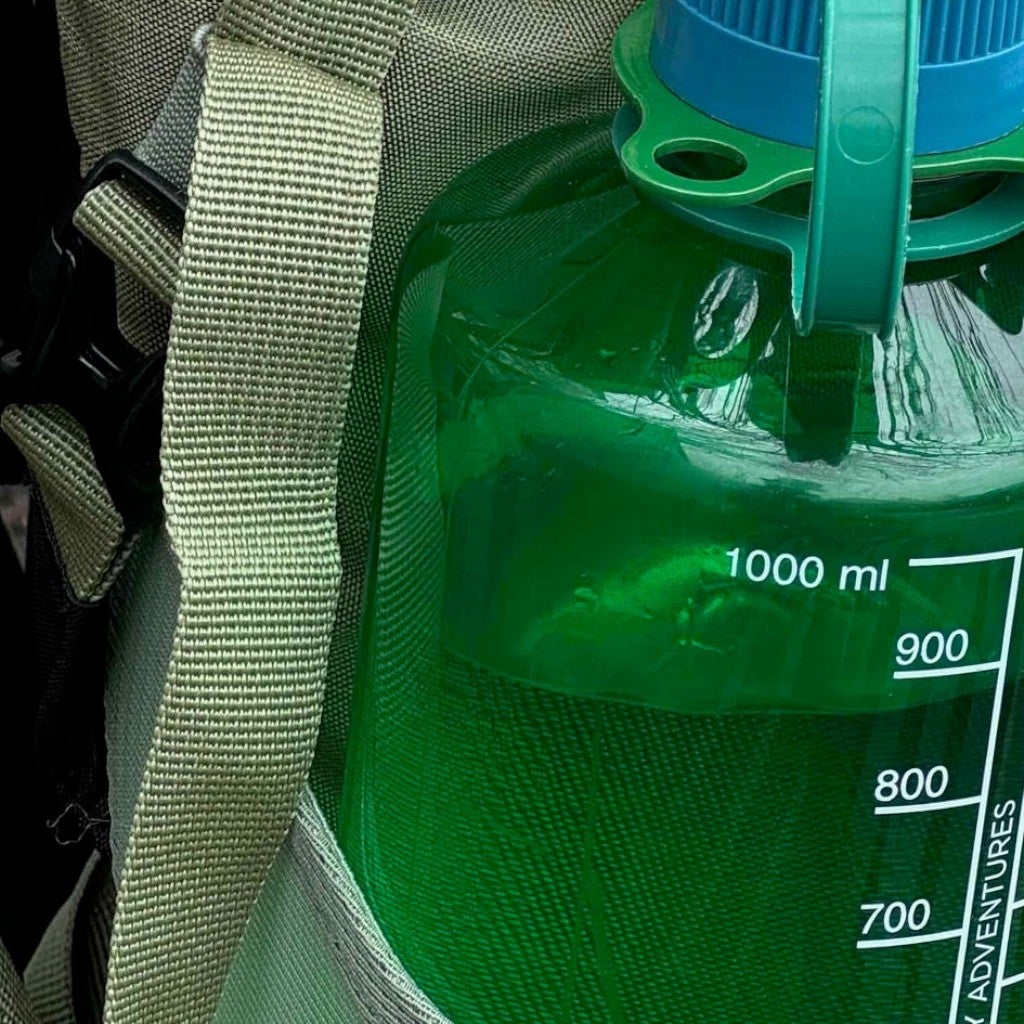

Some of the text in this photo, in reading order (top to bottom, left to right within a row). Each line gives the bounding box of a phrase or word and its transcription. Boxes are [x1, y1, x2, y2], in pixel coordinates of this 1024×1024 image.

[725, 547, 890, 592] 1000 ml
[894, 629, 969, 666] 900
[873, 764, 949, 803] 800
[859, 897, 932, 936] 700
[966, 798, 1017, 1003] ADVENTURES
